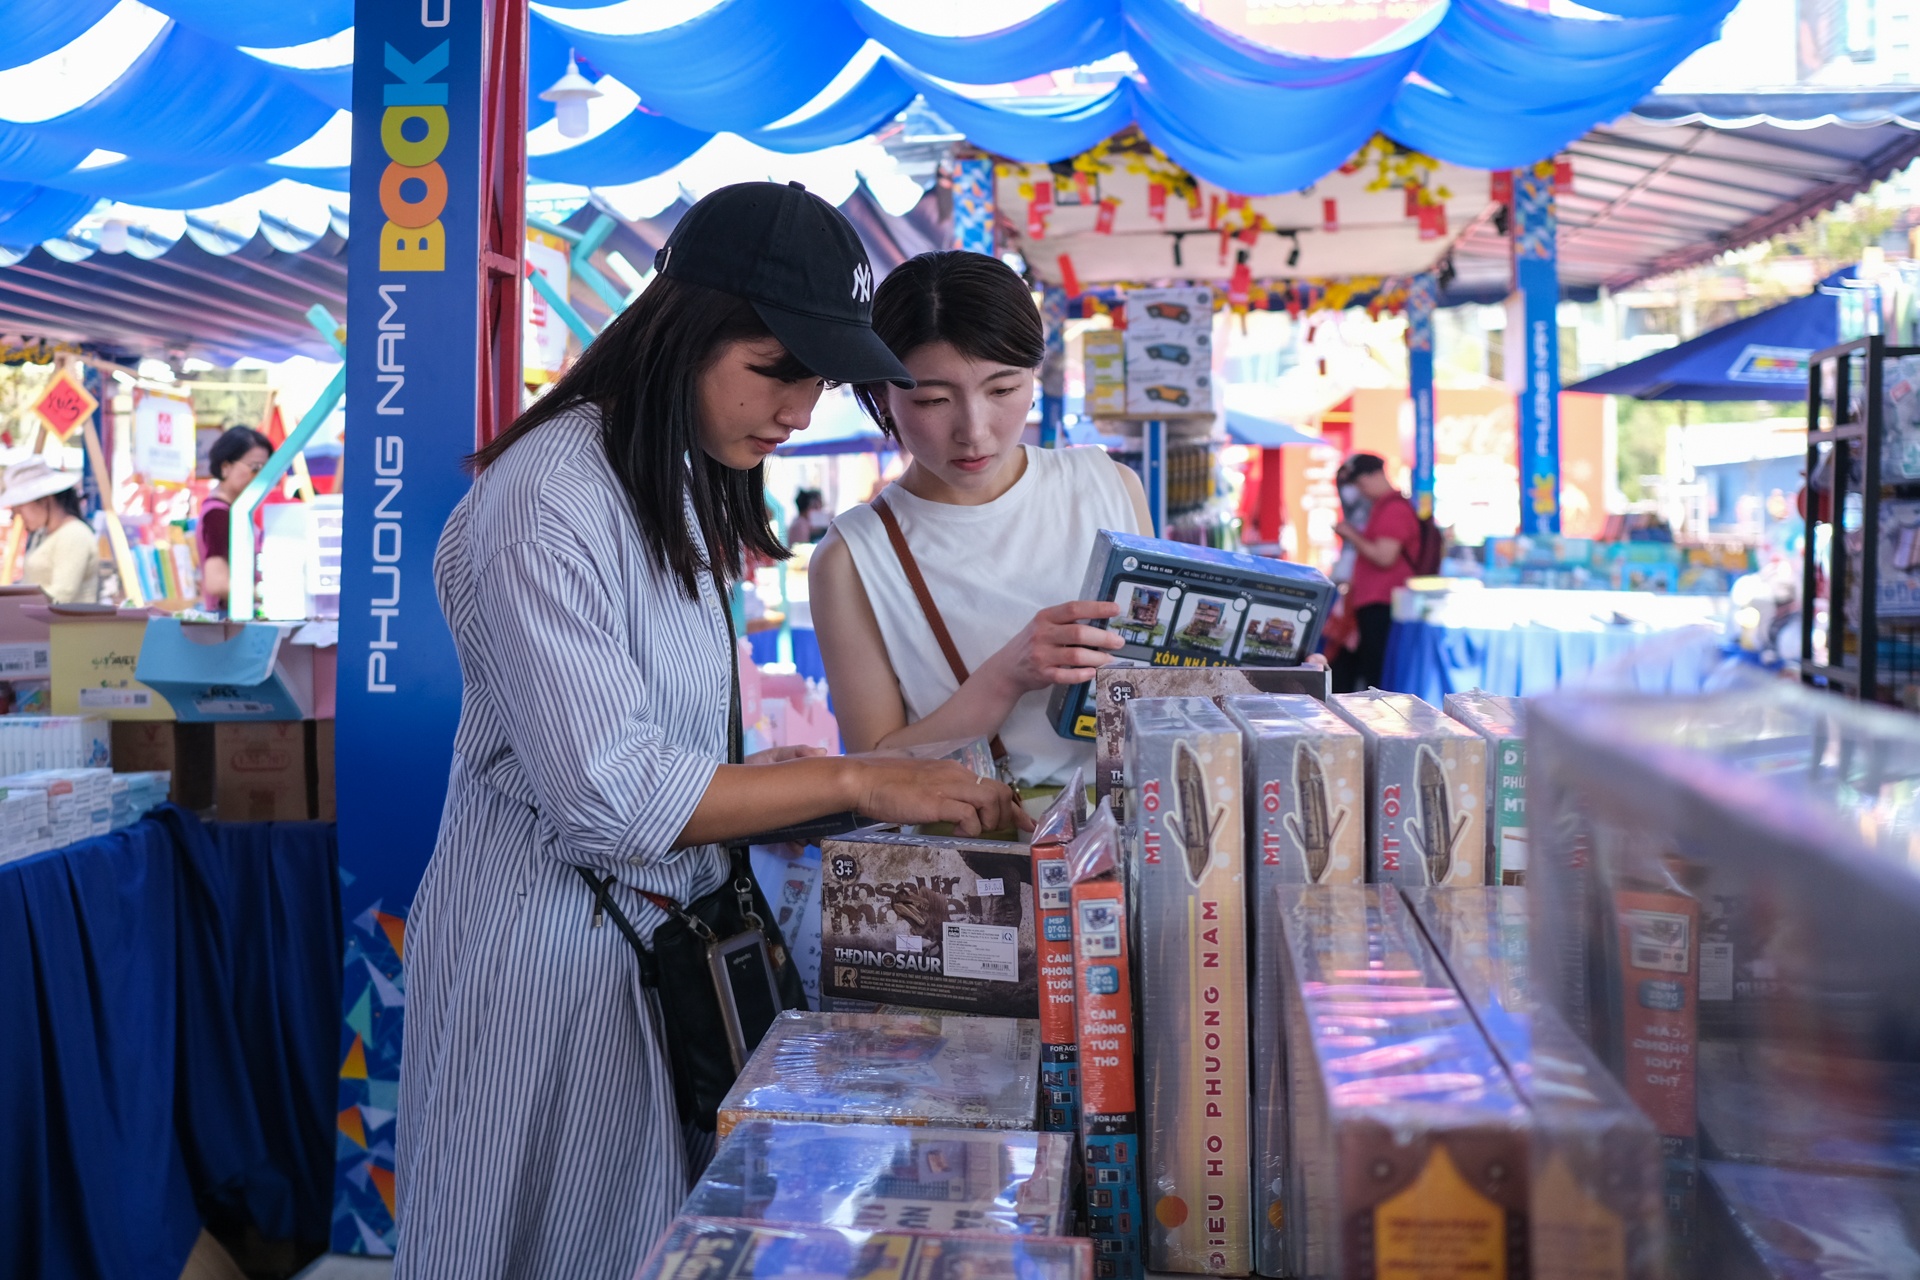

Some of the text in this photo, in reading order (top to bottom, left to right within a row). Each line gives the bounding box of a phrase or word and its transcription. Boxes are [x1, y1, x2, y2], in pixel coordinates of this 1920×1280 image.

[378, 38, 450, 272] BOOK
[852, 262, 871, 302] NY
[376, 284, 406, 415] NAM
[367, 436, 404, 693] PHUONG
[1154, 650, 1180, 665] XÓM
[834, 948, 853, 959] THE
[852, 949, 942, 973] DINOSAUR
[1202, 901, 1220, 968] NAM
[1108, 1114, 1127, 1122] AGE
